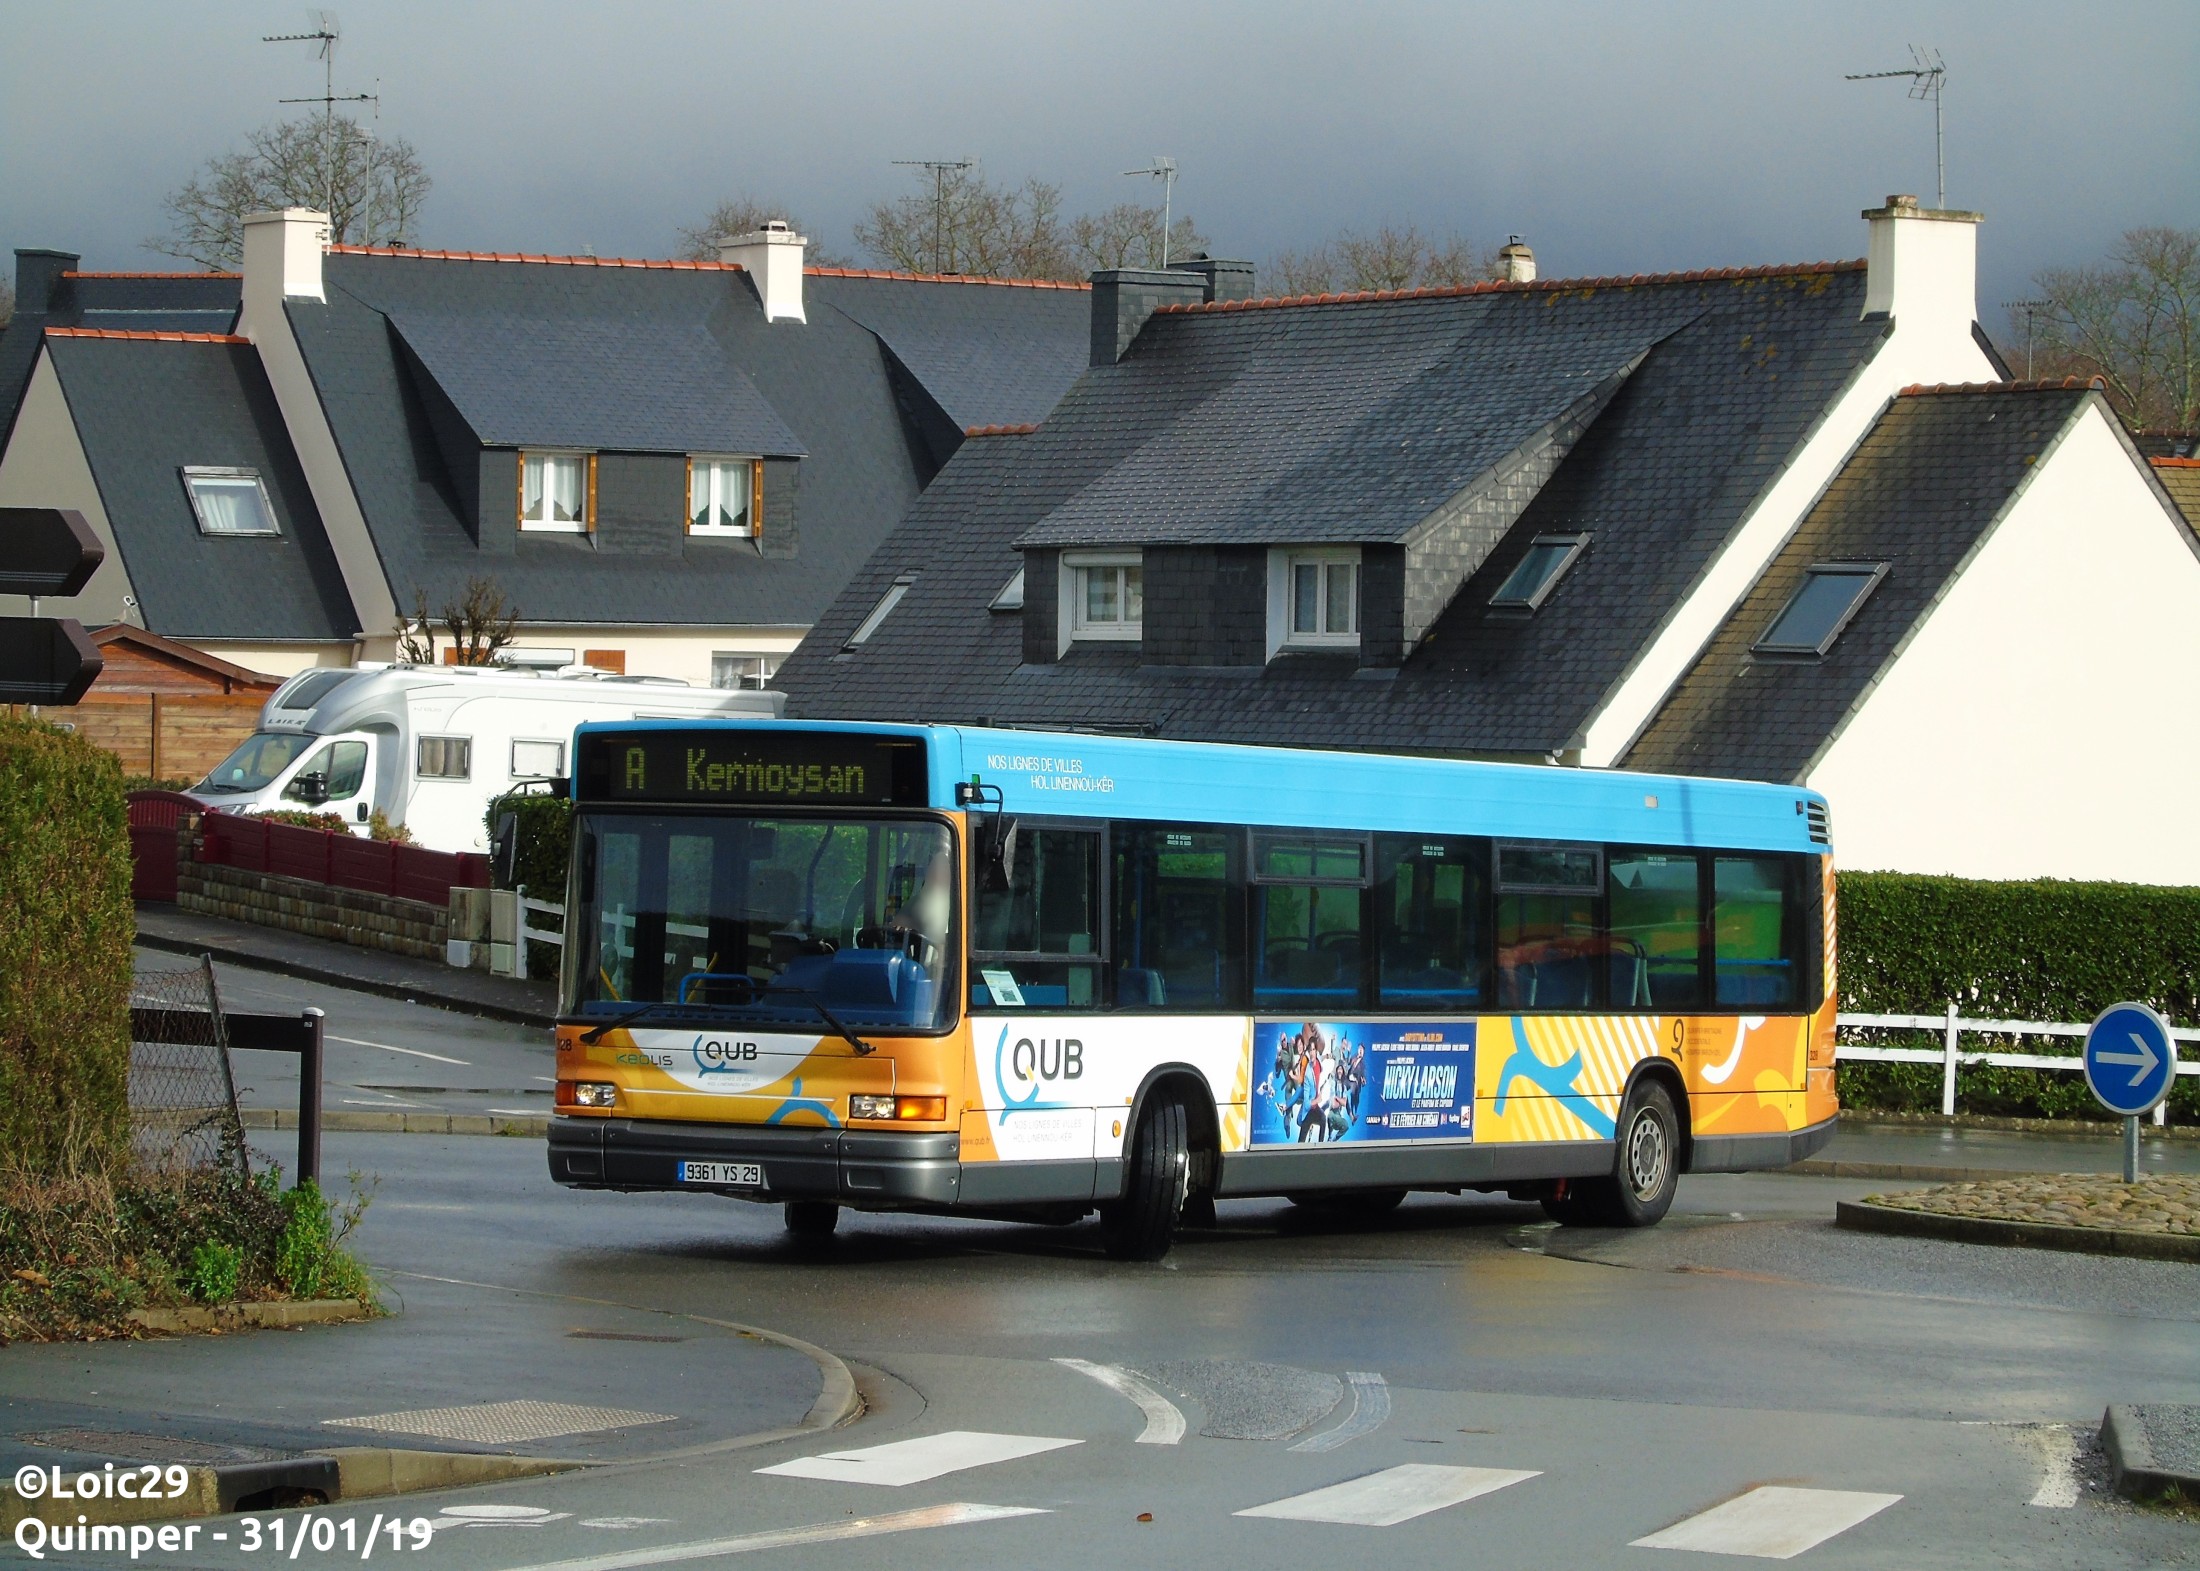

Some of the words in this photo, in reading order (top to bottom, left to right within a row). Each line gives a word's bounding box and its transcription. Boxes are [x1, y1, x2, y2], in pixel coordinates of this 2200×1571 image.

[626, 748, 645, 789] A
[687, 748, 864, 795] Kermoysan
[987, 754, 1007, 769] NOS
[1009, 755, 1040, 772] LIGNES
[1041, 757, 1052, 772] DE
[1054, 758, 1082, 774] VILLES
[1031, 775, 1049, 789] HOL
[705, 1040, 758, 1062] QUB
[1013, 1038, 1083, 1082] QUB
[1383, 1066, 1415, 1099] NICKY
[1413, 1066, 1458, 1099] LARSON
[687, 1164, 715, 1180] 9361
[723, 1165, 737, 1181] YS
[744, 1167, 758, 1182] 29
